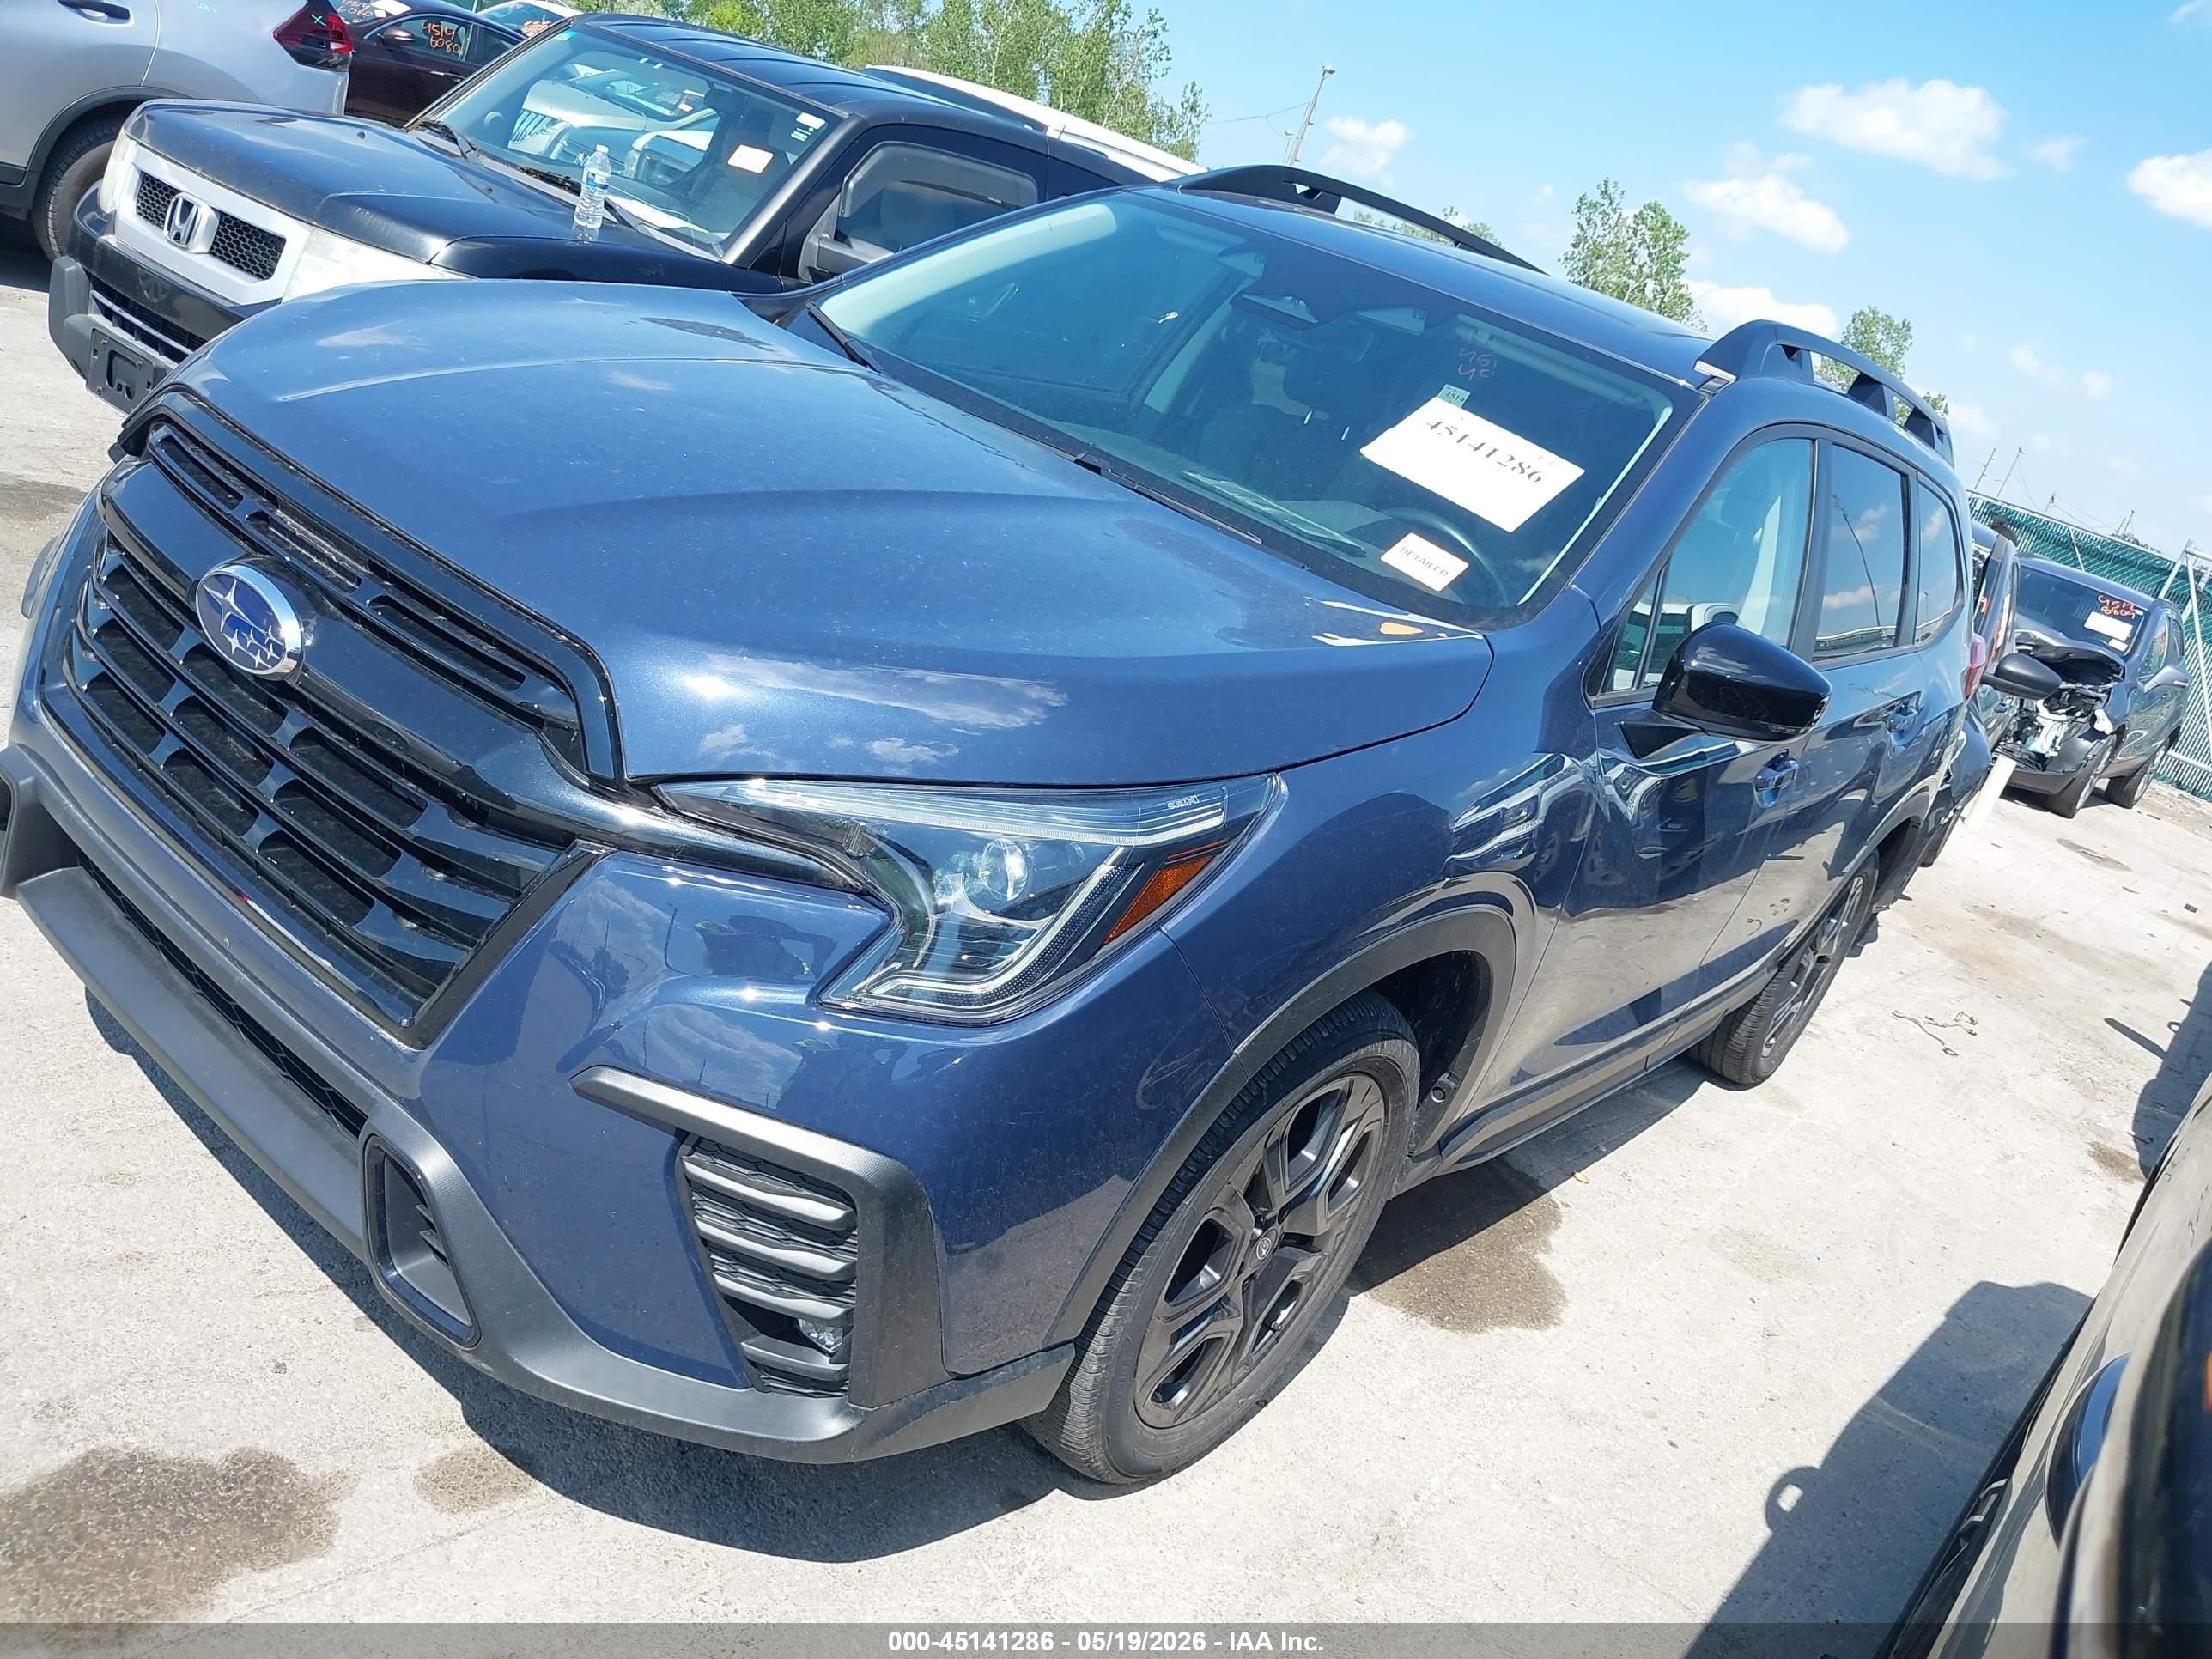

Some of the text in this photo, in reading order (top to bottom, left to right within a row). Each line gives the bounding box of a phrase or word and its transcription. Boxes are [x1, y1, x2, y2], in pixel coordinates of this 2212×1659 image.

[422, 19, 455, 40] 4514
[430, 36, 463, 53] 6080
[1426, 420, 1542, 483] 45141286
[1400, 547, 1449, 576] DETAILED
